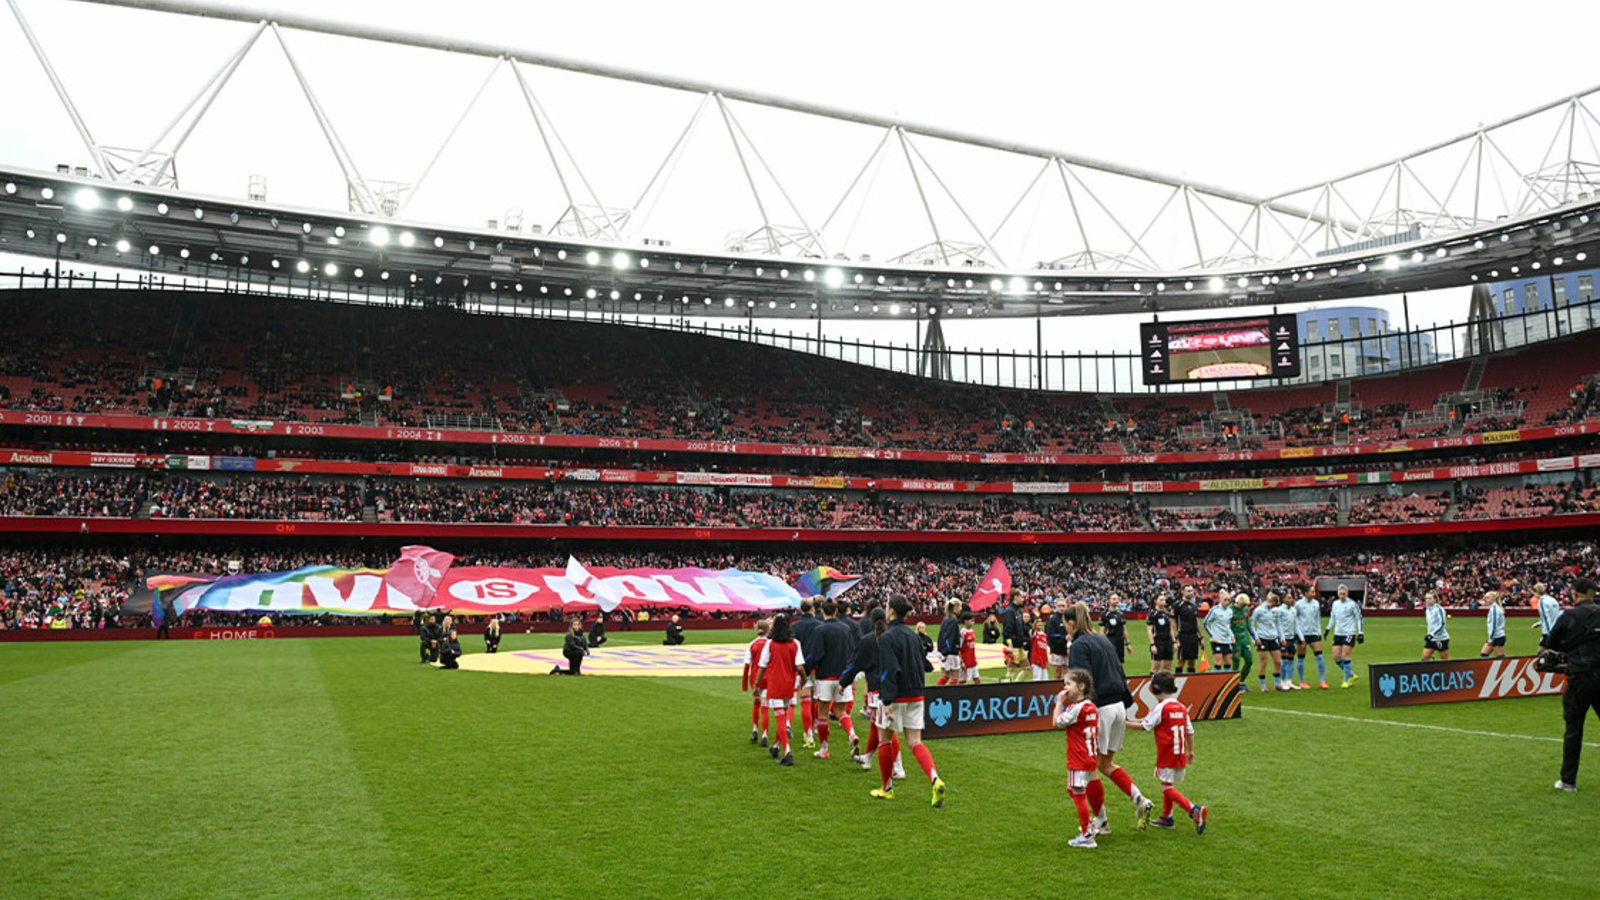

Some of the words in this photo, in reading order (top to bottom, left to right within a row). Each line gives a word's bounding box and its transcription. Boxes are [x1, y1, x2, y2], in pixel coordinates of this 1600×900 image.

[26, 414, 52, 424] 2001
[174, 420, 200, 430] 2002
[298, 426, 324, 435] 2003
[397, 430, 421, 440] 2004
[1555, 427, 1575, 436] 2016
[502, 435, 525, 443] 2005
[599, 438, 620, 447] 2006
[1443, 438, 1462, 447] 2015
[688, 442, 707, 450] 2007
[10, 451, 53, 464] Arsenal
[469, 467, 503, 477] Arsenal
[1402, 470, 1434, 480] Arsenal
[786, 477, 814, 486] Arsenal
[1209, 479, 1262, 489] AUSTRALIA
[1103, 482, 1129, 492] Arsenal
[475, 581, 517, 599] IS
[210, 631, 257, 640] HOME
[1400, 670, 1474, 694] BARCLAYS
[1169, 724, 1185, 756] 11
